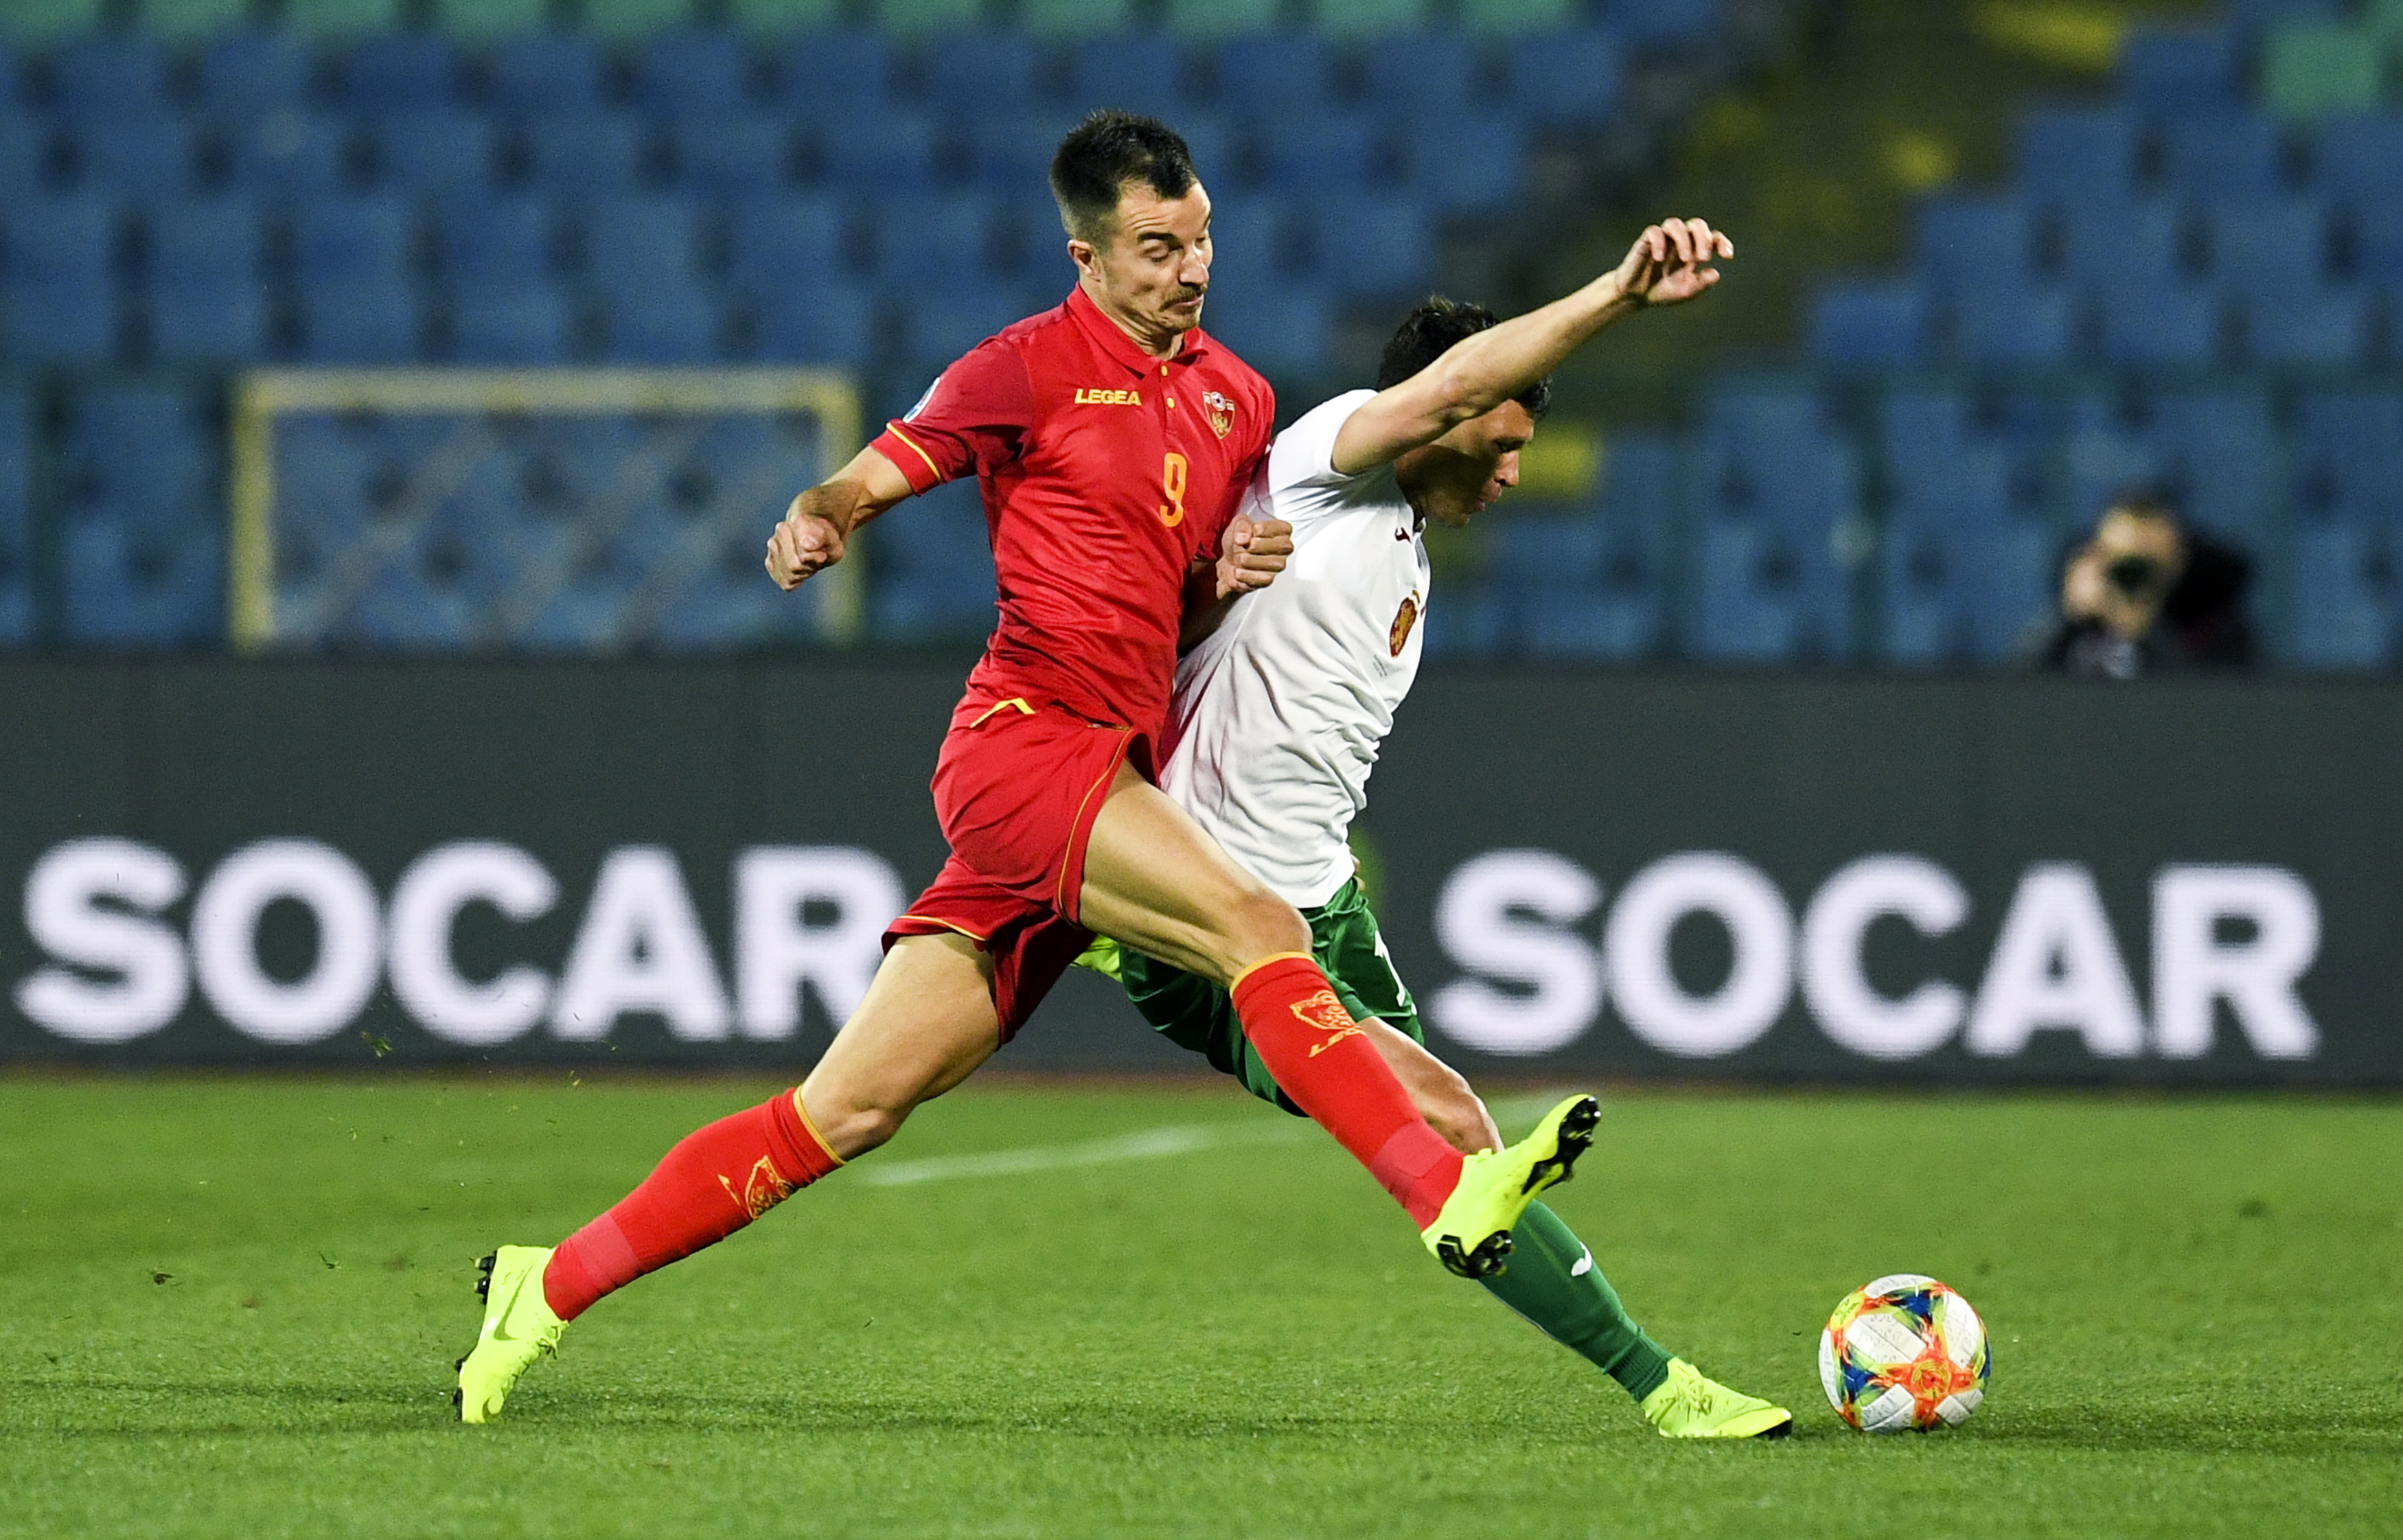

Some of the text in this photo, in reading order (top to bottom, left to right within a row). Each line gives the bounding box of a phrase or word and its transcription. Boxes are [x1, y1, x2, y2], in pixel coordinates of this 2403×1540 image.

[1074, 388, 1142, 406] LEGEA
[1160, 452, 1186, 527] 9
[18, 838, 906, 1044] SOCAR
[1431, 851, 2321, 1059] SOCAR
